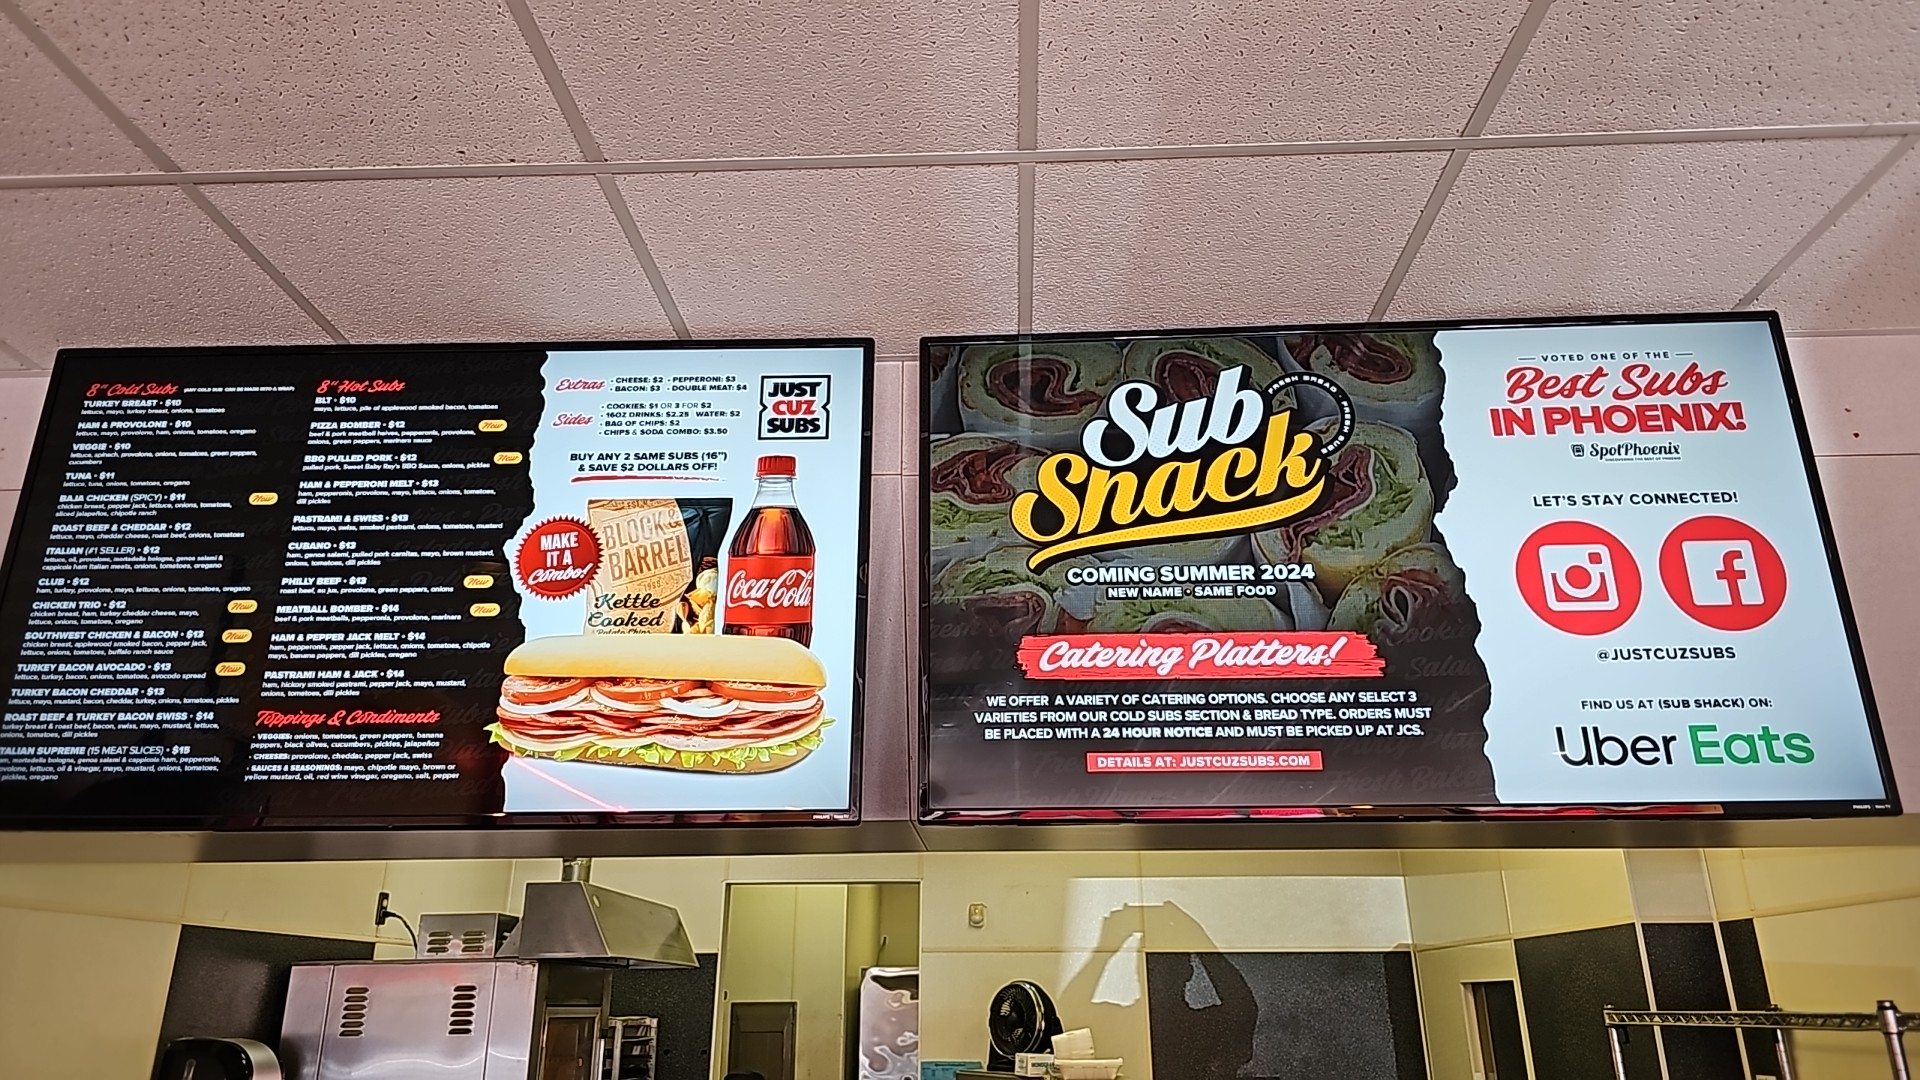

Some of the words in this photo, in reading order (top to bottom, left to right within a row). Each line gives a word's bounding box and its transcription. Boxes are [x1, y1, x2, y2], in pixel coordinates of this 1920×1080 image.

[107, 384, 141, 396] Cold
[141, 383, 179, 395] Subs
[337, 380, 367, 393] Hot
[367, 380, 406, 392] Subs
[555, 378, 606, 392] Extras
[768, 382, 822, 398] JUST
[1506, 366, 1609, 403] Best
[1613, 362, 1729, 400] Subs
[164, 398, 182, 407] $10
[772, 400, 817, 416] CUZ
[552, 414, 594, 427] Sides
[1083, 366, 1264, 466] Sub
[1490, 408, 1535, 436] IN
[1543, 402, 1747, 435] PHOENIX!
[767, 418, 821, 434] SUBS
[326, 454, 364, 462] PULLED
[399, 453, 417, 462] $12
[497, 454, 518, 462] New
[597, 452, 620, 460] ANY
[633, 452, 665, 460] SAME
[668, 452, 698, 460] SUBS
[1590, 442, 1680, 460] SpotPhoenix
[588, 463, 618, 471] SAVE
[620, 463, 634, 472] $2
[637, 462, 689, 471] DOLLARS
[692, 462, 717, 470] OFF!
[130, 493, 162, 502] (SPICY)
[169, 492, 186, 501] $11
[1581, 494, 1623, 506] STAY
[1629, 491, 1738, 505] CONNECTED!
[603, 511, 666, 551] BLOCK
[667, 508, 682, 528] &
[540, 532, 578, 550] MAKE
[547, 552, 560, 566] IT
[562, 550, 572, 565] A
[608, 534, 690, 581] BARREL
[1067, 567, 1155, 583] COMING
[1160, 566, 1255, 582] SUMMER
[1260, 564, 1315, 580] 2024
[1108, 586, 1138, 597] NEW
[1143, 586, 1182, 597] NAME
[1194, 584, 1233, 596] SAME
[1237, 585, 1276, 596] FOOD
[276, 605, 328, 614] MEATBALL
[329, 604, 374, 613] BOMBER
[381, 603, 399, 613] $14
[594, 593, 660, 610] Kettle
[588, 610, 664, 627] Cooked
[1040, 639, 1183, 675] Catering
[1188, 637, 1348, 669] Platters!
[1598, 646, 1736, 660] @JUSTCUZSUBS
[17, 663, 57, 672] TURKEY
[57, 663, 94, 671] BACON
[94, 662, 146, 671] AVOCADO
[153, 661, 171, 672] $13
[218, 665, 242, 673] New
[986, 695, 1006, 707] WE
[1008, 695, 1049, 706] OFFER
[1054, 695, 1064, 705] A
[1066, 694, 1119, 705] VARIETY
[1121, 694, 1139, 705] OF
[1141, 693, 1206, 705] CATERING
[1208, 692, 1268, 704] OPTIONS.
[1270, 692, 1326, 704] CHOOSE
[1328, 691, 1356, 703] ANY
[1358, 691, 1406, 702] SELECT
[1407, 691, 1417, 702] 3
[1581, 700, 1612, 709] FIND
[1616, 699, 1634, 709] US
[1638, 699, 1653, 709] AT
[1658, 699, 1691, 709] (SUB
[1694, 697, 1744, 708] SHACK)
[1748, 698, 1772, 707] ON:
[255, 710, 326, 728] Toppings
[327, 710, 346, 725] &
[346, 710, 440, 724] Condiments
[974, 711, 1038, 723] VARIETIES
[1040, 711, 1077, 722] FROM
[1079, 711, 1107, 722] OUR
[1109, 710, 1146, 721] COLD
[1147, 710, 1182, 721] SUBS
[1184, 709, 1240, 721] SECTION
[1242, 709, 1252, 720] &
[1254, 709, 1298, 720] BREAD
[1299, 708, 1336, 720] TYPE.
[1338, 707, 1392, 719] ORDERS
[1394, 707, 1431, 719] MUST
[1556, 726, 1677, 766] Uber
[1688, 724, 1815, 765] Eats
[1097, 756, 1152, 768] DETAILS
[1154, 757, 1177, 768] AT:
[1179, 755, 1310, 766] JUSTCUZSUBS.COM
